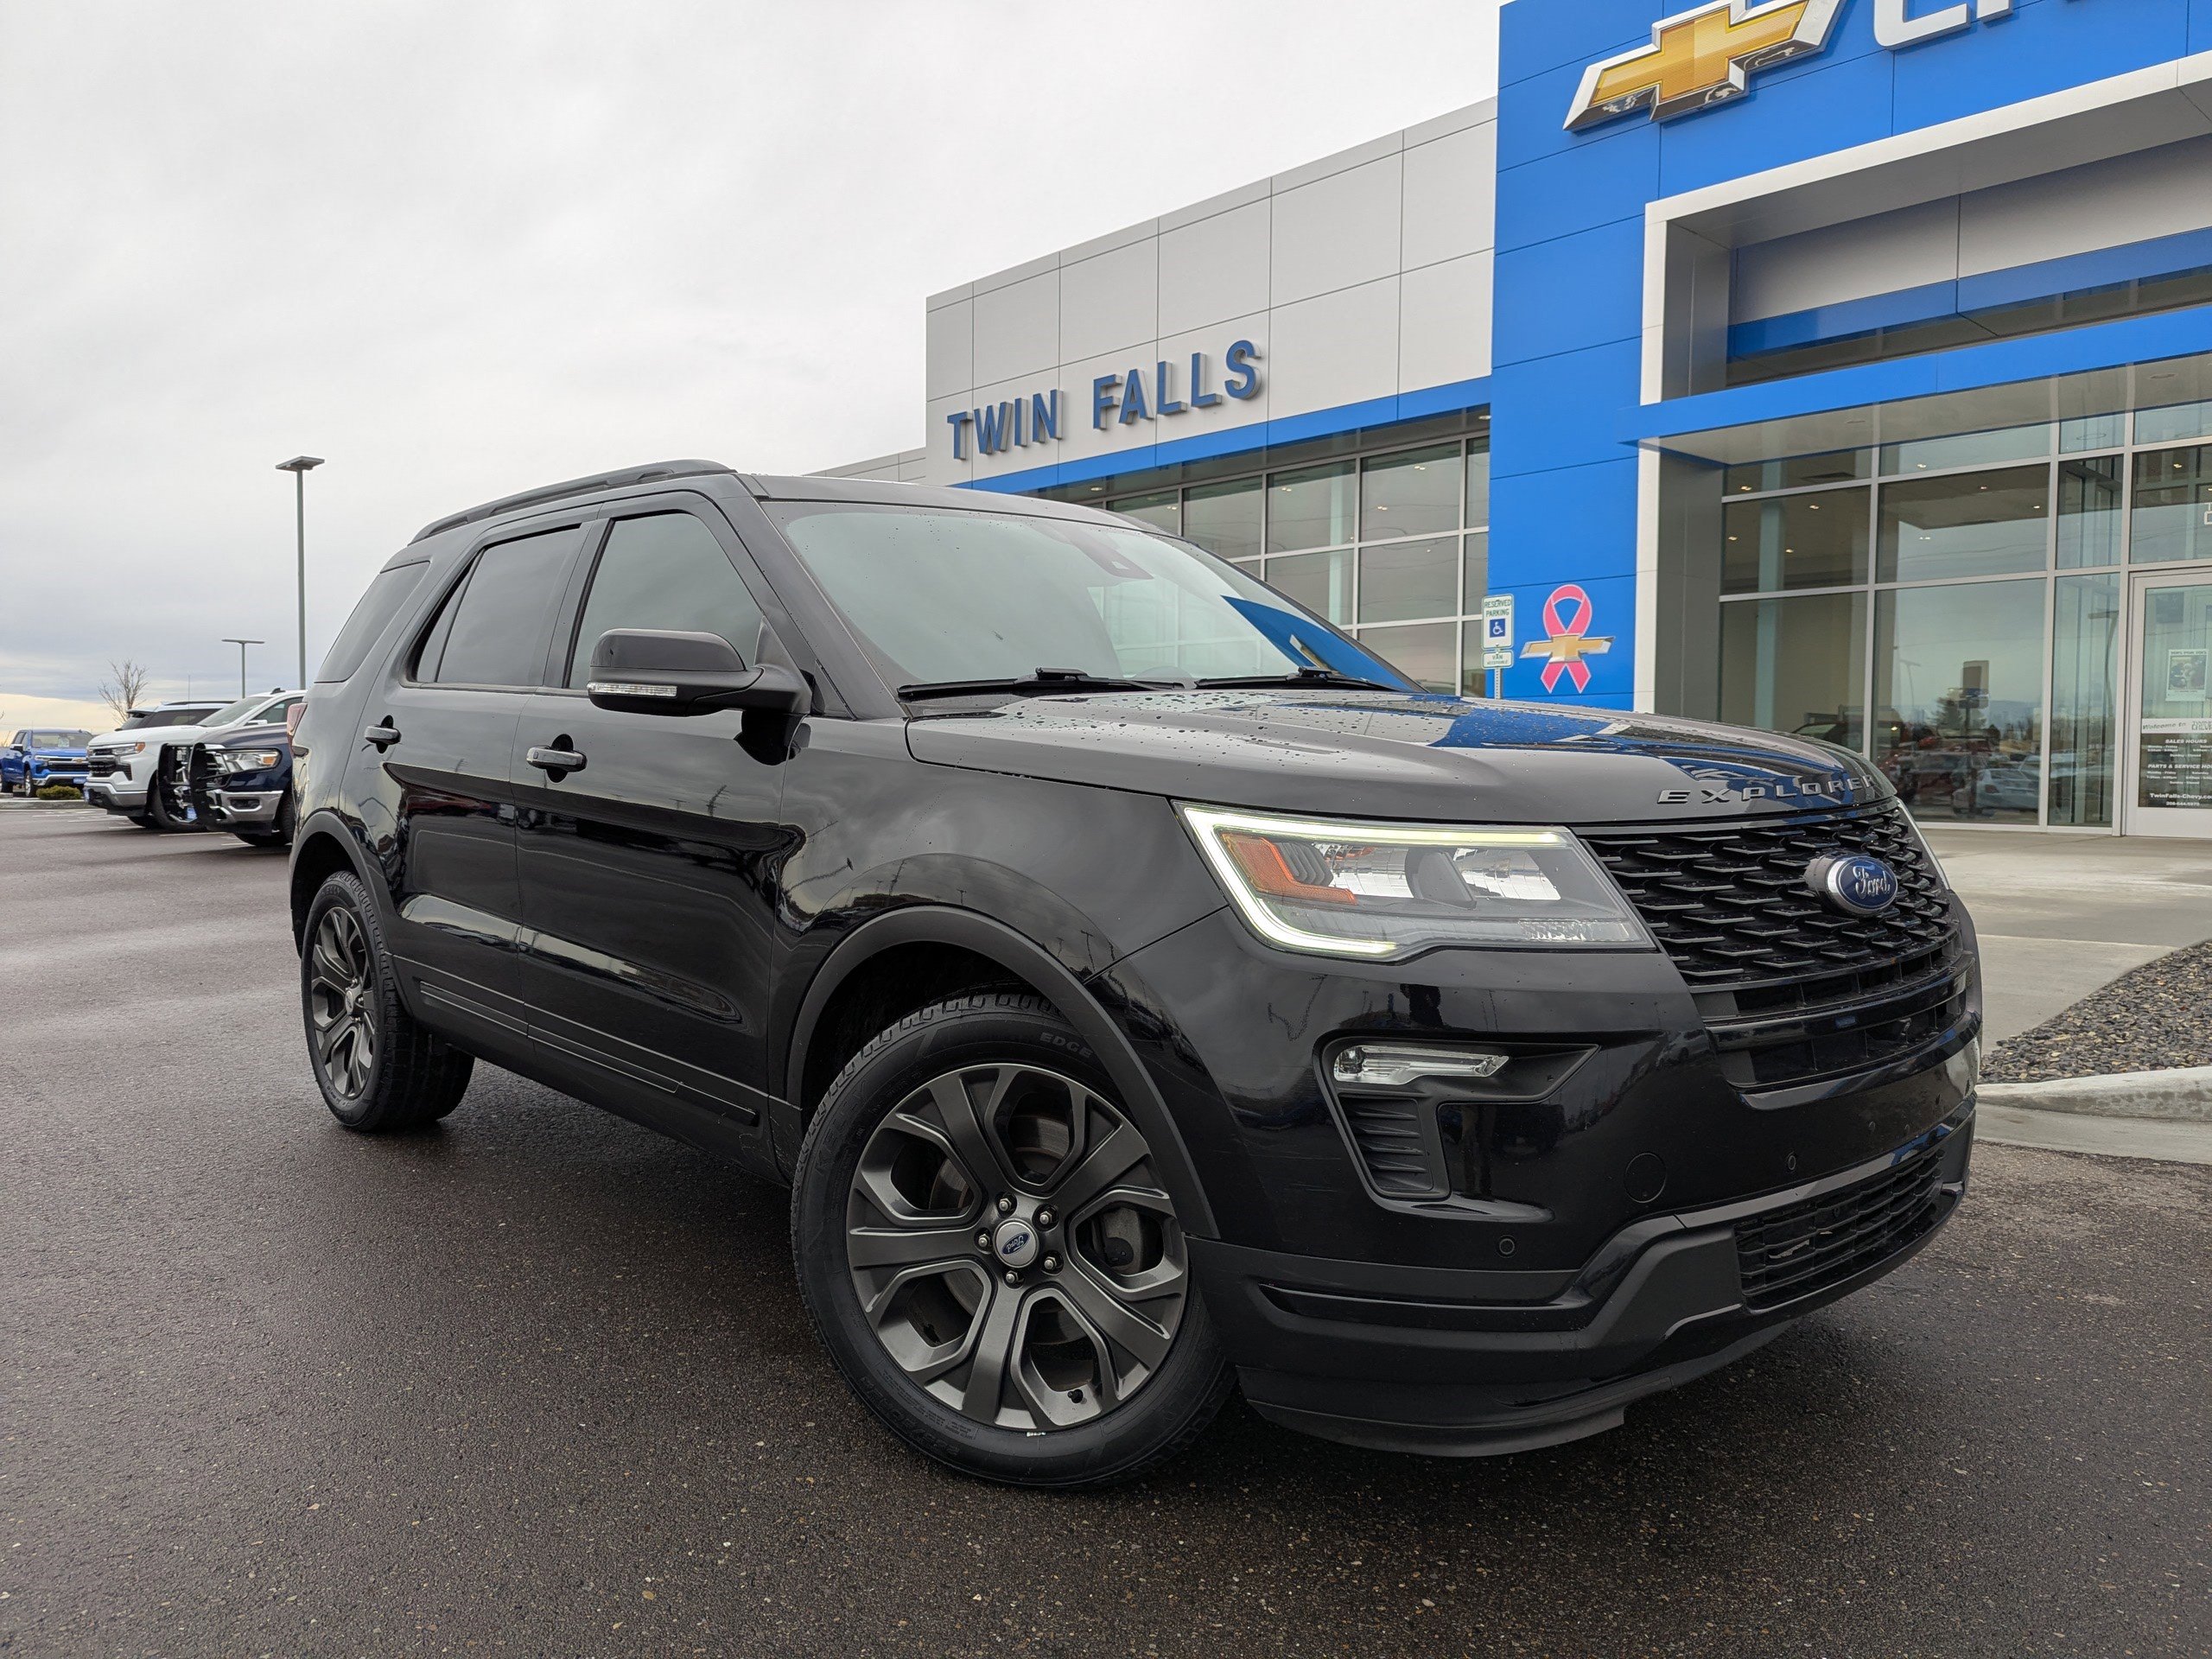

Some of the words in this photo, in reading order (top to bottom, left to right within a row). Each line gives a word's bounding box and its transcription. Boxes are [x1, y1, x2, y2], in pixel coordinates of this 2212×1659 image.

[947, 389, 1064, 461] TWIN
[1093, 340, 1262, 430] FALLS
[1484, 599, 1511, 608] RESERVED
[1485, 608, 1510, 617] PARKING
[1656, 775, 1875, 804] EXPLORER
[1854, 865, 1891, 899] Ford
[1039, 1032, 1094, 1058] EDGE
[1005, 1235, 1024, 1253] Ford
